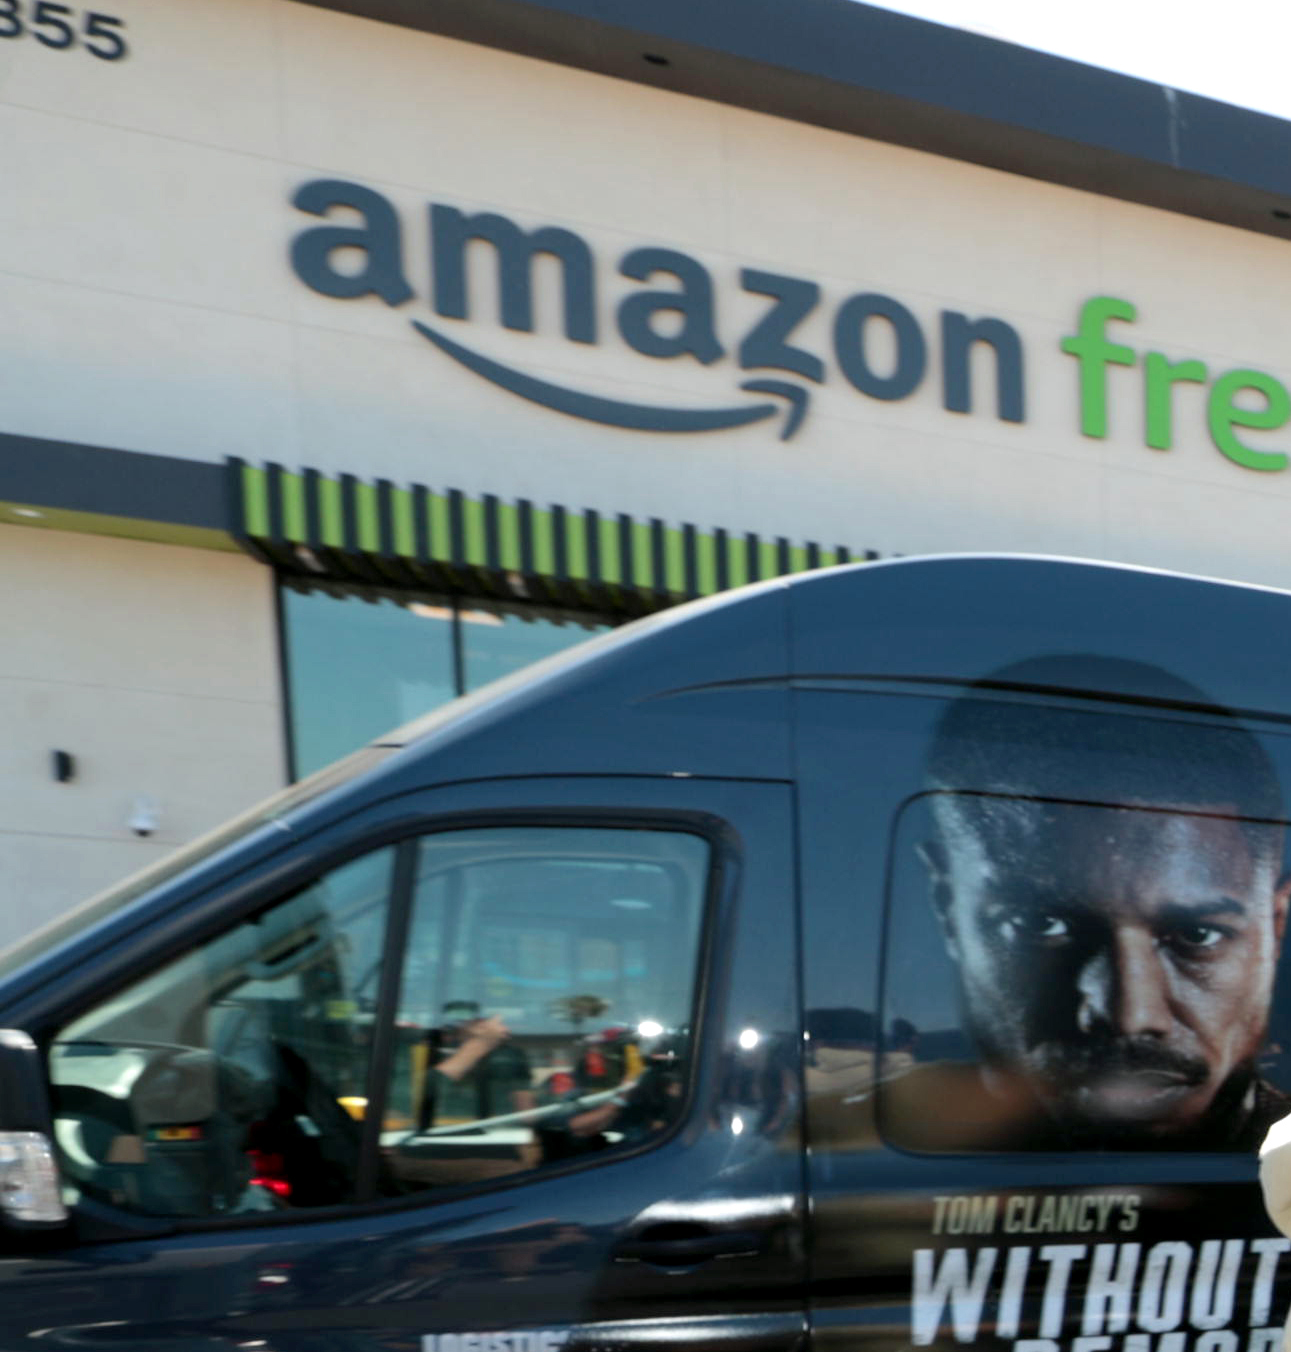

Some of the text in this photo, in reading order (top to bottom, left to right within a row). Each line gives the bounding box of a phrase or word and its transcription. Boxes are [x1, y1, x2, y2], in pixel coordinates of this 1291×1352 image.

[290, 178, 1026, 424] amazon
[932, 1194, 1142, 1235] TOM CLANCY'S
